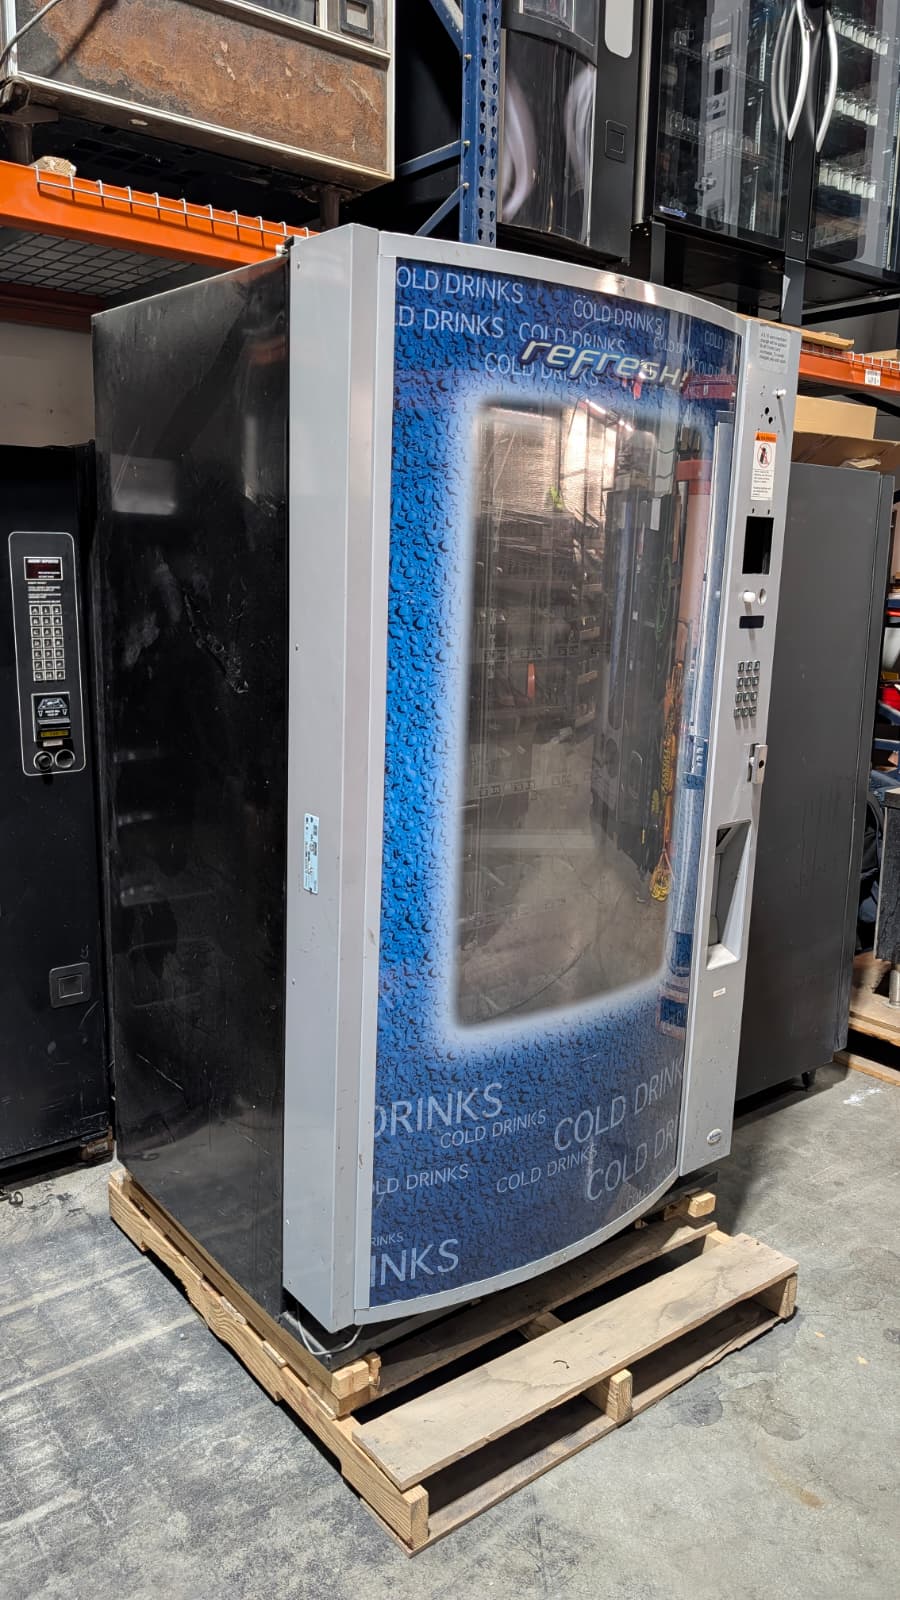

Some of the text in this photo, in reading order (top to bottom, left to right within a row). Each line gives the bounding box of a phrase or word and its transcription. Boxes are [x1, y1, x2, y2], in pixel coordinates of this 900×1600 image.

[396, 266, 524, 304] OLD DRINKS
[395, 305, 504, 339] D DRINKS
[573, 299, 664, 337] COLD DRINKS
[572, 330, 626, 353] DRINKS
[375, 1082, 503, 1138] DRINKS
[440, 1109, 547, 1149] COLD DRINKS
[554, 1096, 627, 1151] COLD
[406, 1163, 470, 1191] DRINKS
[496, 1143, 598, 1193] COLD DRINKS
[587, 1142, 649, 1201] COLD
[370, 1238, 460, 1288] INKS
